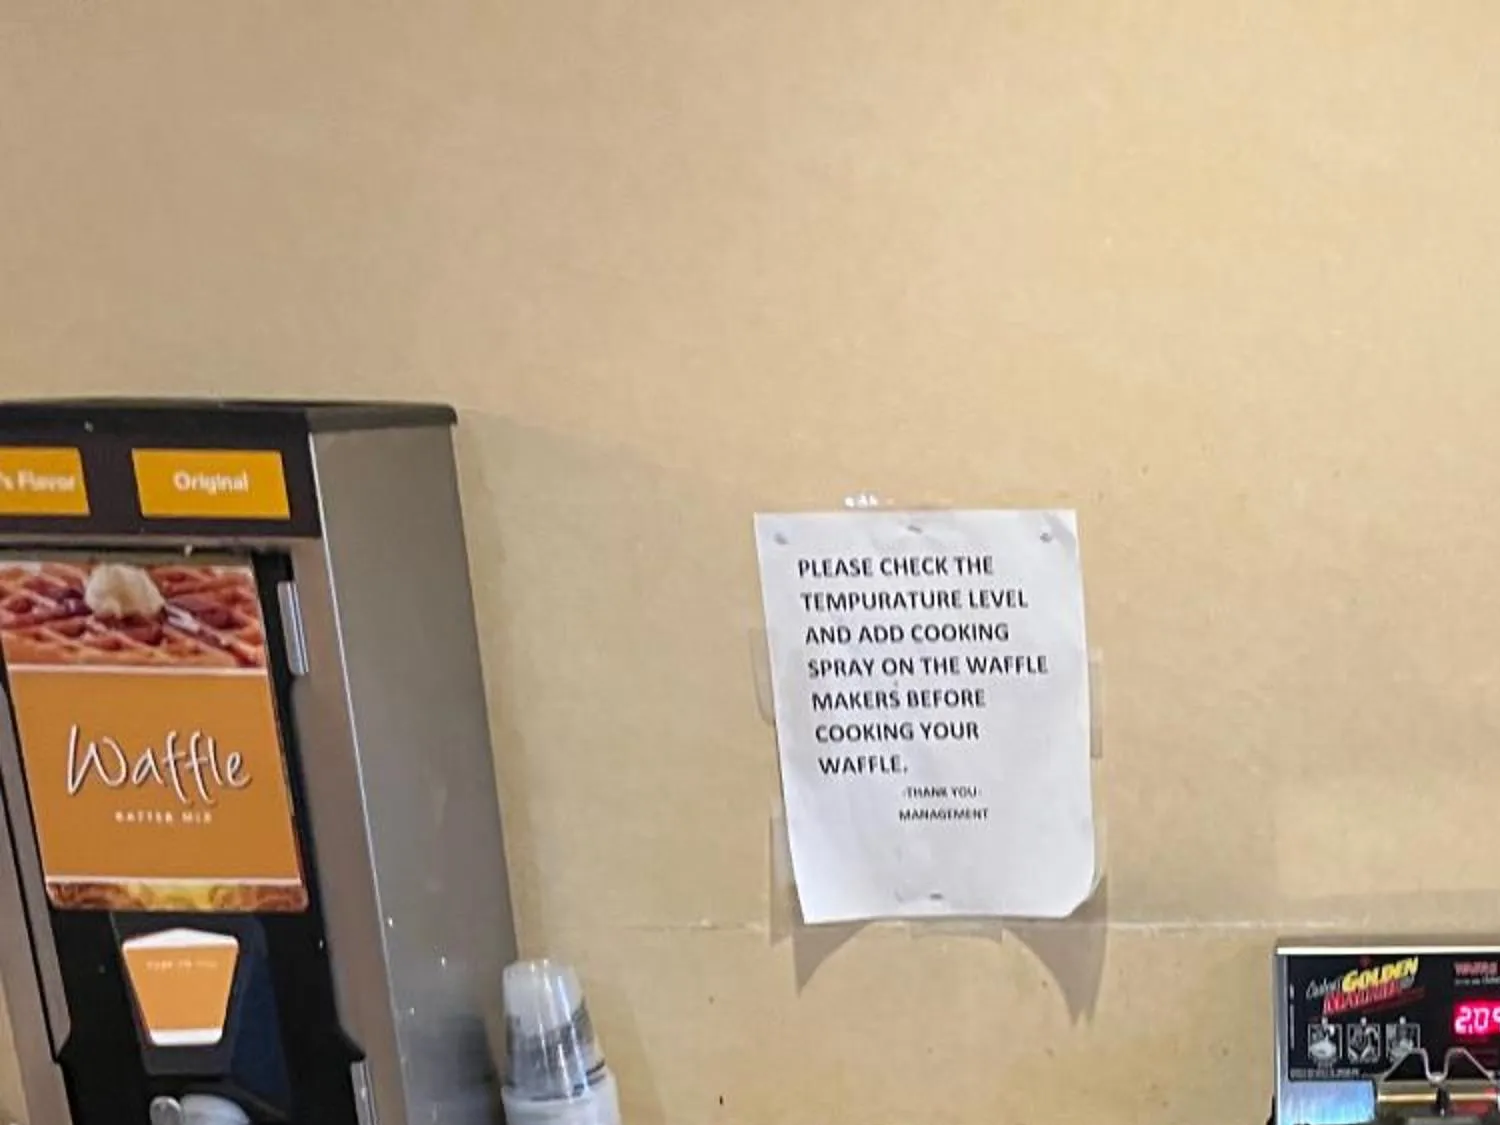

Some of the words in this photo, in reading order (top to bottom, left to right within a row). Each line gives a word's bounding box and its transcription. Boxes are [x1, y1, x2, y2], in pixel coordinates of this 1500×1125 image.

[17, 469, 76, 492] Flavor
[173, 470, 249, 495] Original
[798, 556, 874, 578] PLEASE
[880, 556, 948, 576] CHECK
[954, 555, 994, 575] THE
[800, 590, 962, 611] TEMPURATURE
[969, 589, 1029, 609] LEVEL
[805, 625, 852, 645] AND
[858, 624, 905, 644] ADD
[910, 623, 1009, 643] COOKING
[807, 658, 875, 679] SPRAY
[881, 657, 914, 677] ON
[919, 657, 959, 675] THE
[966, 655, 1048, 675] WAFFLE
[812, 690, 900, 711] MAKERS
[907, 689, 986, 709] BEFORE
[815, 722, 914, 743] COOKING
[919, 721, 979, 741] YOUR
[65, 723, 254, 805] Waffle
[818, 754, 909, 776] WAFFLE.
[899, 807, 989, 823] MANAGEMENT
[1342, 956, 1419, 993] GOLDEN
